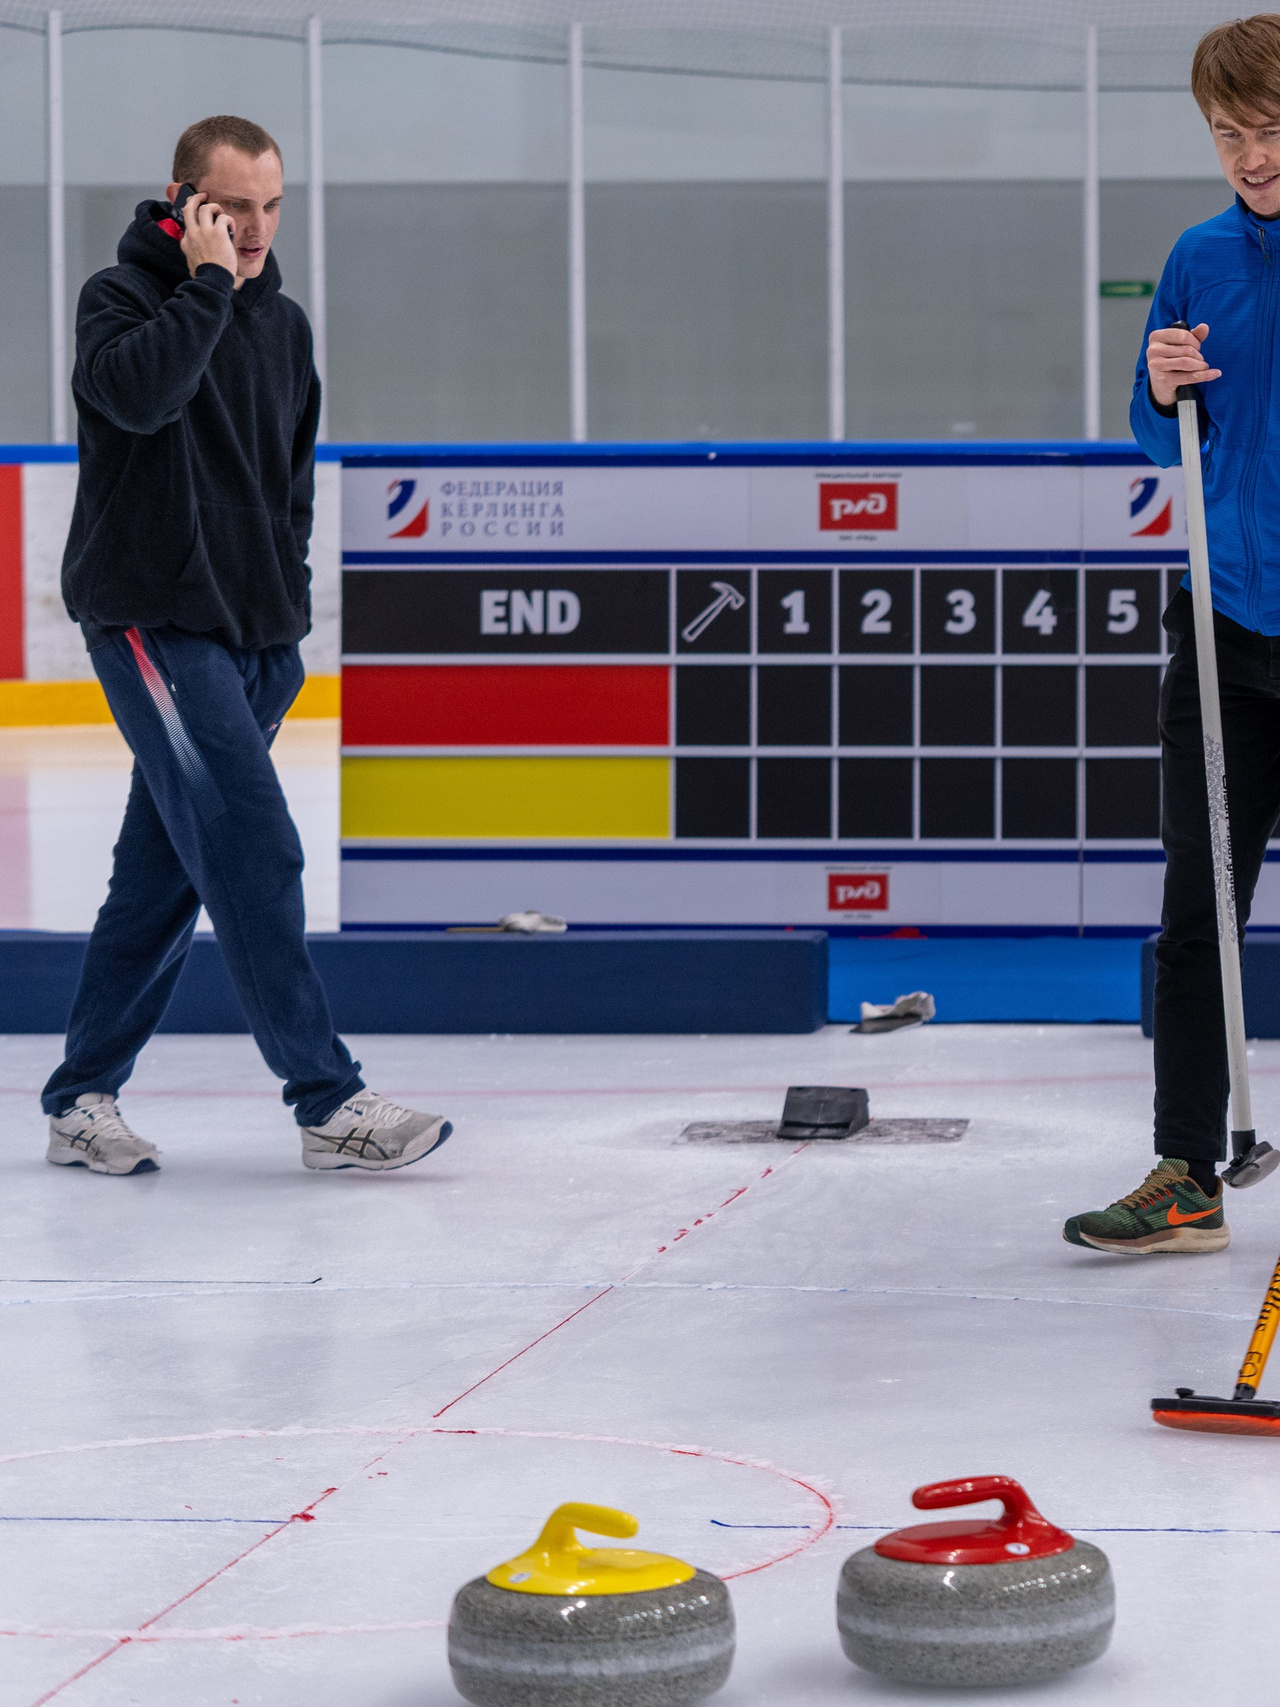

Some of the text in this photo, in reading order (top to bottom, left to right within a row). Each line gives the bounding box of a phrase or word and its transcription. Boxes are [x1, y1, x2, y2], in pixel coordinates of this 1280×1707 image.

[440, 480, 563, 497] ФЕДЕРАЦИЯ
[441, 521, 563, 537] РОССИИ
[480, 590, 581, 635] END
[781, 590, 810, 634] 1
[861, 589, 892, 634] 2
[945, 589, 977, 635] 3
[1022, 589, 1057, 635] 4
[1107, 589, 1140, 634] 5
